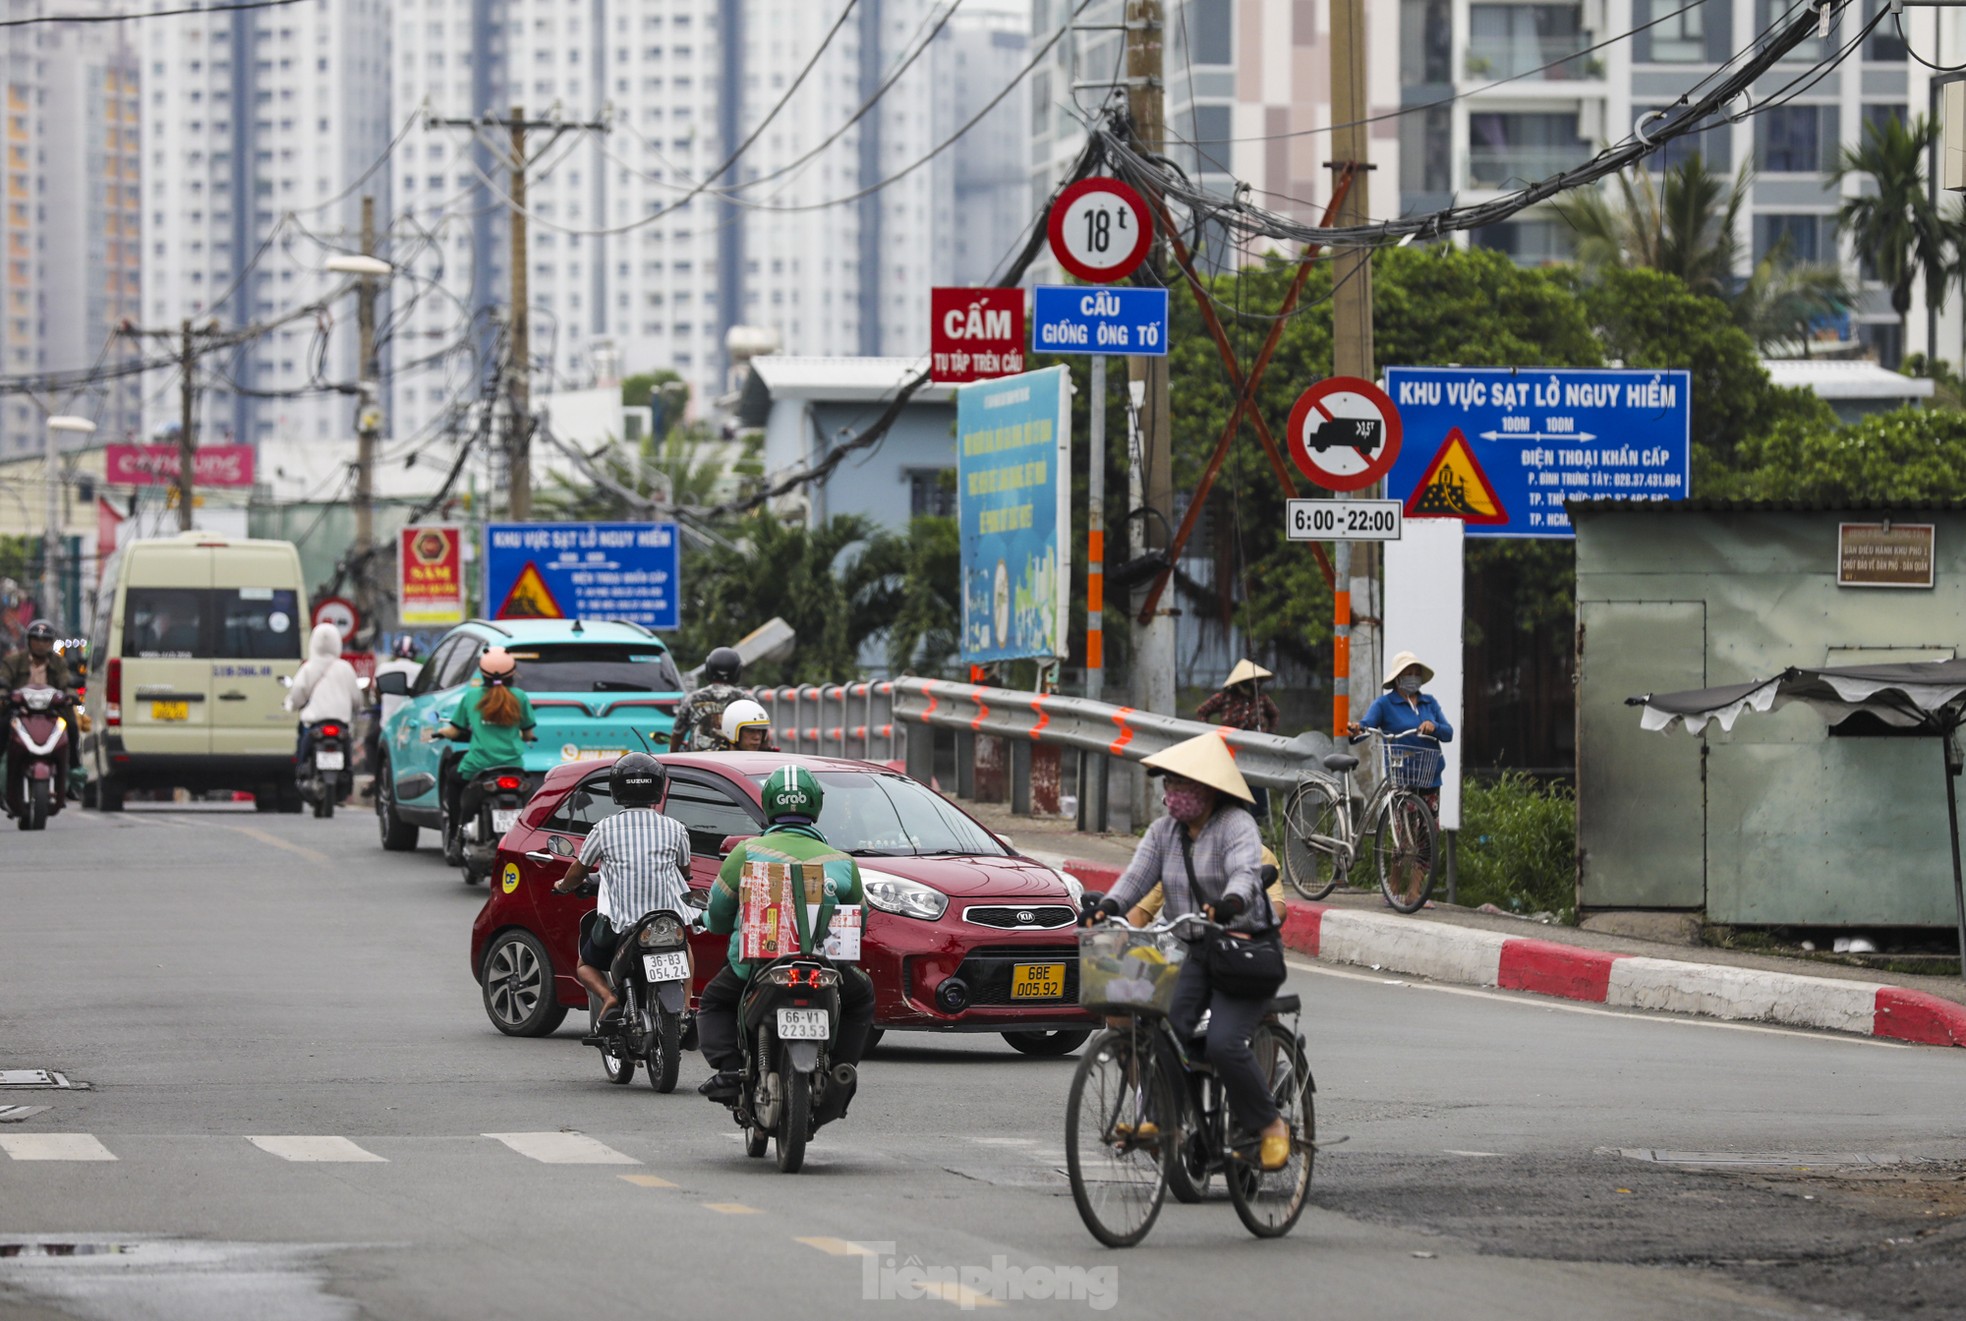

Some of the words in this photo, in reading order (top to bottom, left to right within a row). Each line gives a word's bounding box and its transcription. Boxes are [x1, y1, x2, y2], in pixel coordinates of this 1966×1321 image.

[1084, 208, 1110, 252] 18
[1080, 290, 1120, 316] CẦU
[943, 298, 1012, 340] CẤM
[1042, 318, 1088, 345] GIỒNG
[1097, 322, 1128, 346] ÔNG
[1137, 321, 1161, 347] TỐ
[934, 353, 949, 377] TỤ
[950, 348, 971, 377] TẬP
[972, 349, 1000, 373] TRÊN
[1400, 381, 1441, 406] KHU
[1446, 378, 1487, 412] VỰC
[1491, 383, 1530, 412] SẠT
[1535, 374, 1560, 407] LỞ
[1566, 384, 1620, 408] NGUY
[1626, 374, 1676, 408] HIỂM
[1502, 416, 1530, 432] 100M
[1546, 417, 1574, 432] 100M
[1521, 447, 1554, 470] ĐIỆN
[1558, 449, 1598, 469] THOẠI
[1602, 443, 1638, 466] KHẨN
[1642, 445, 1670, 466] CẤP
[1528, 472, 1538, 486] P.
[776, 791, 807, 805] Grab
[505, 869, 516, 884] be
[1020, 913, 1033, 921] KIA
[650, 954, 681, 968] 36-B3
[649, 965, 687, 980] 054.24
[1028, 966, 1051, 980] 68E
[1017, 982, 1058, 996] 005.92
[785, 1011, 819, 1024] 66-V1
[781, 1024, 826, 1038] 223.53
